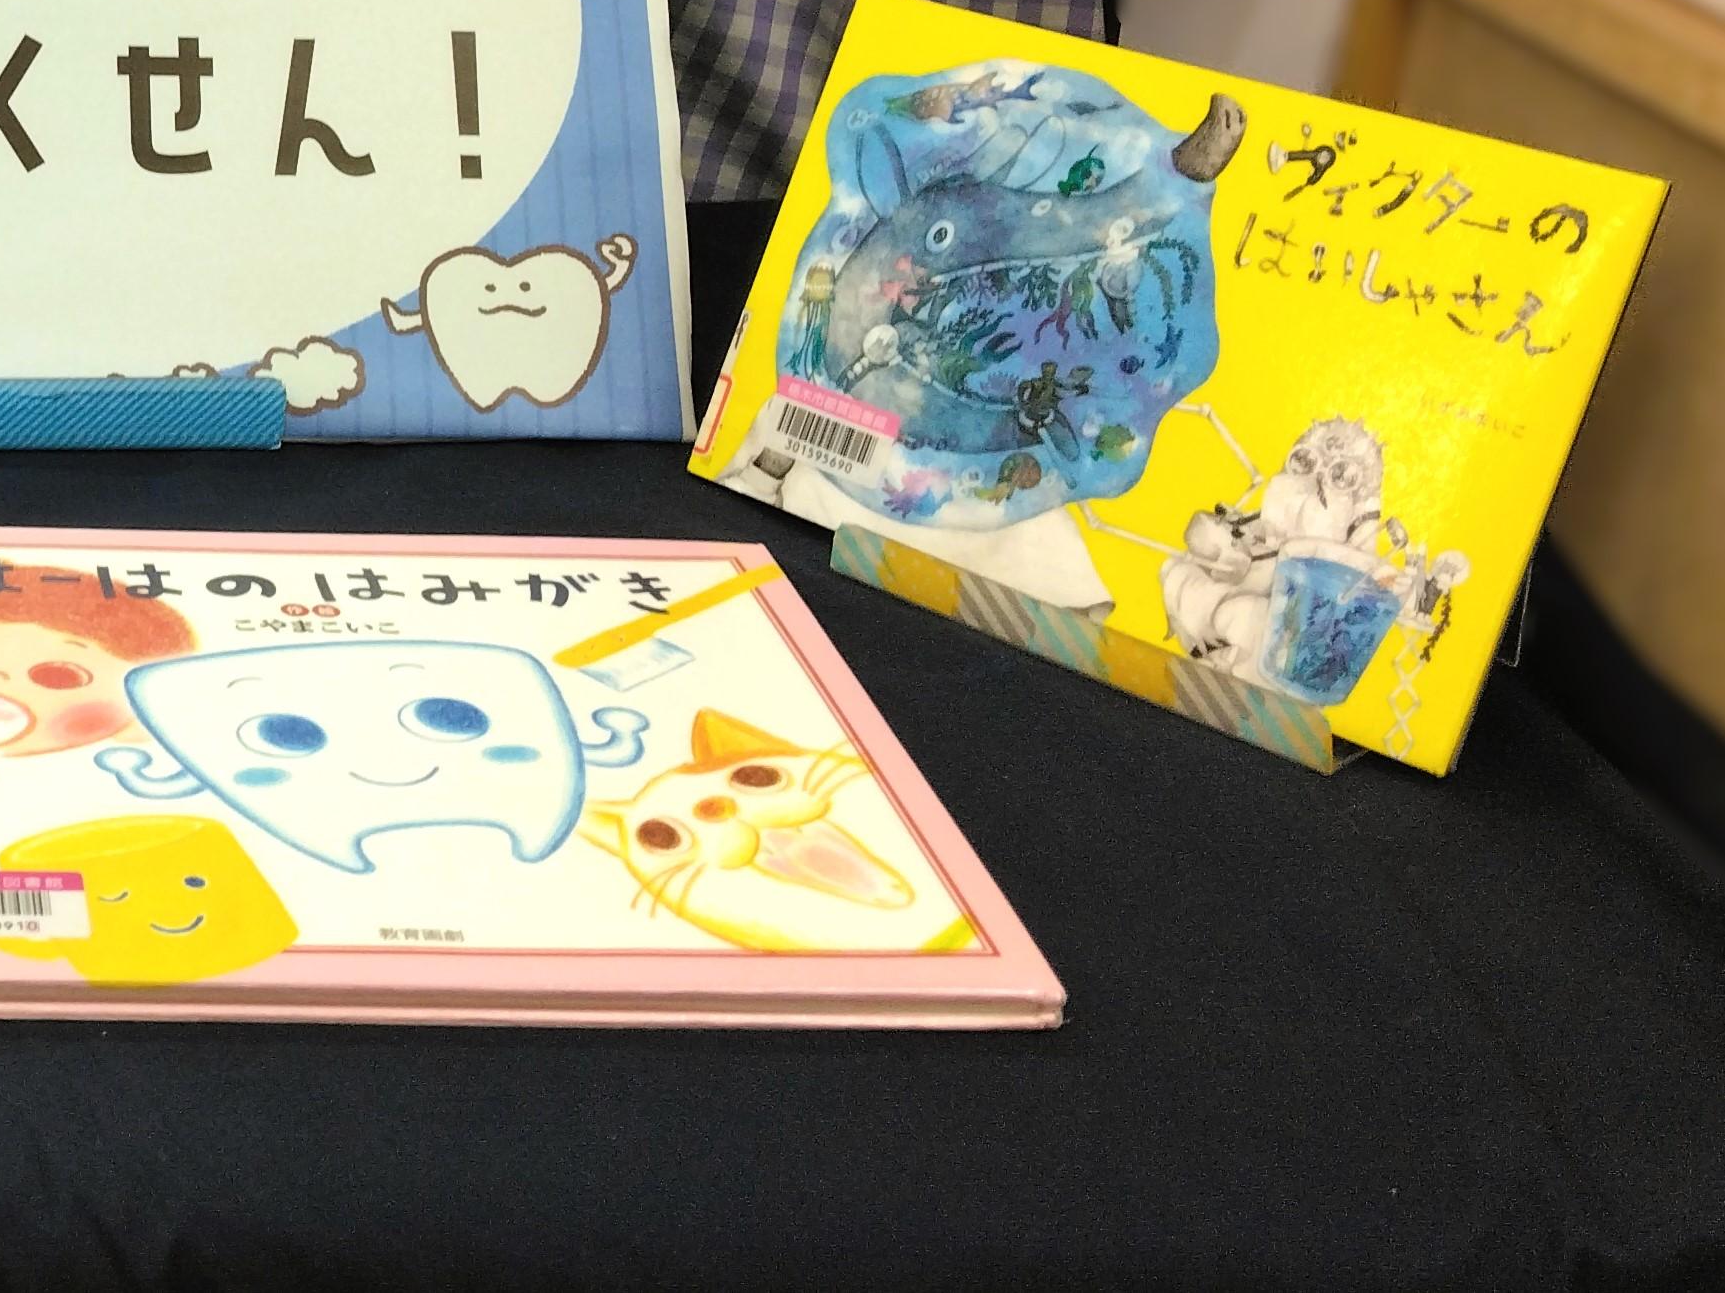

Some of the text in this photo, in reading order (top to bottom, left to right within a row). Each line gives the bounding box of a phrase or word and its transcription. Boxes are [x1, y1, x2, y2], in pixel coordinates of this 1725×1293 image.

[1267, 122, 1590, 255] ヴィクターの
[1234, 212, 1572, 357] はいしゃさん
[784, 438, 854, 474] 301595690
[234, 618, 403, 636] こやまこいこ
